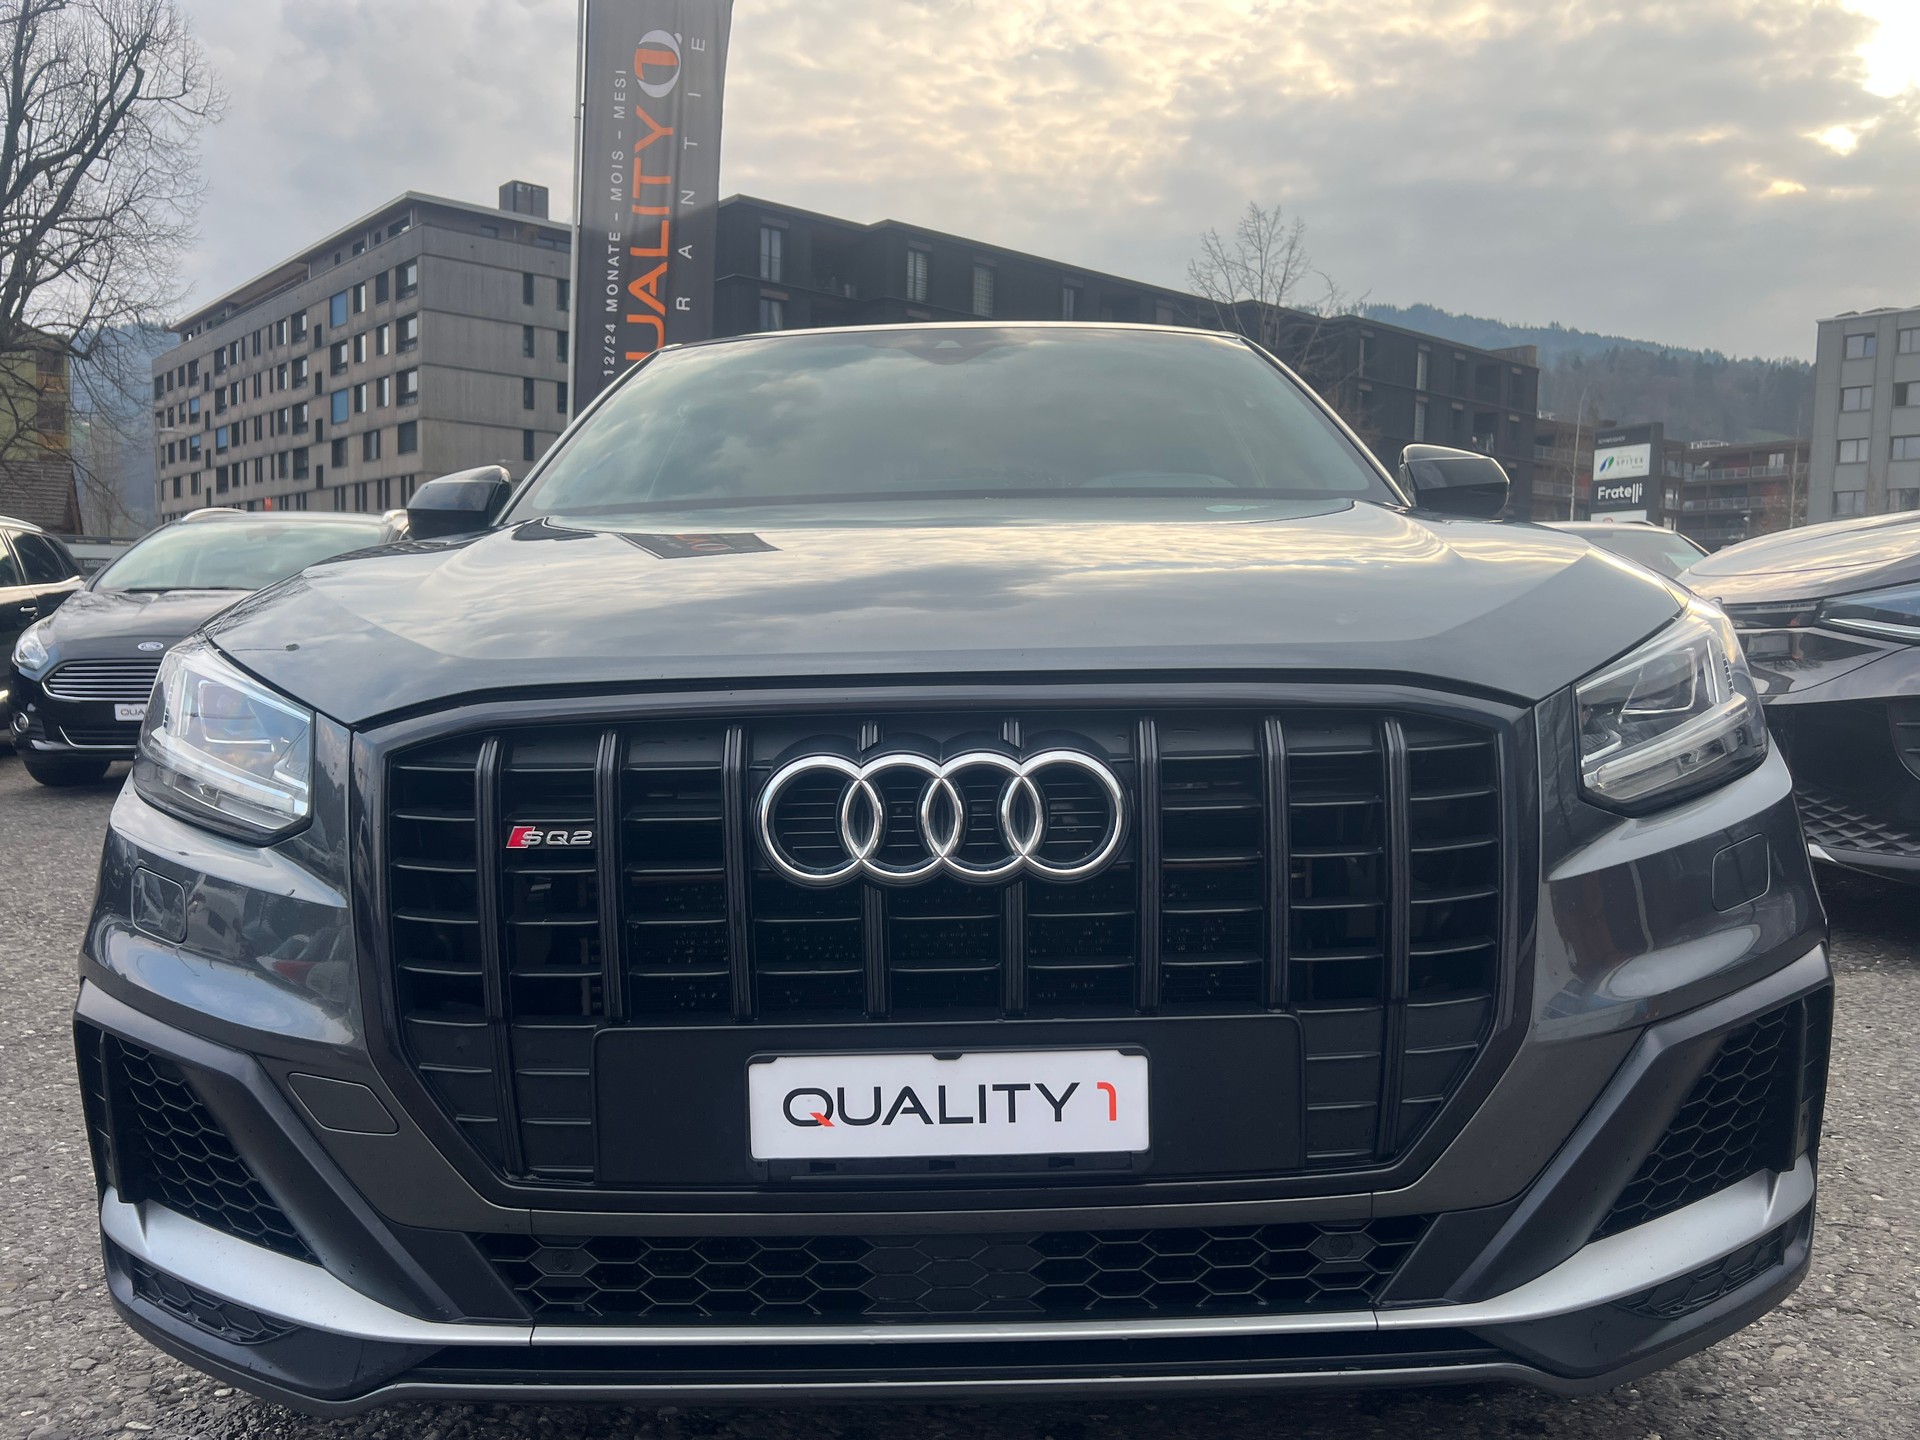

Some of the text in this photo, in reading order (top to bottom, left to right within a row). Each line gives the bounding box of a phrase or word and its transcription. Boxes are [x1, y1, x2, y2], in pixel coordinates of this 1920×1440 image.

[612, 69, 627, 119] MESI
[610, 149, 624, 201] MOIS
[676, 36, 706, 311] RANTIE
[625, 105, 675, 361] UALITY
[606, 231, 621, 312] MONATE
[602, 322, 616, 377] 12/24
[1598, 483, 1642, 504] Fratelli
[120, 708, 145, 716] QUA
[519, 829, 593, 847] SQ2
[782, 1081, 1118, 1128] QUALITY 1
